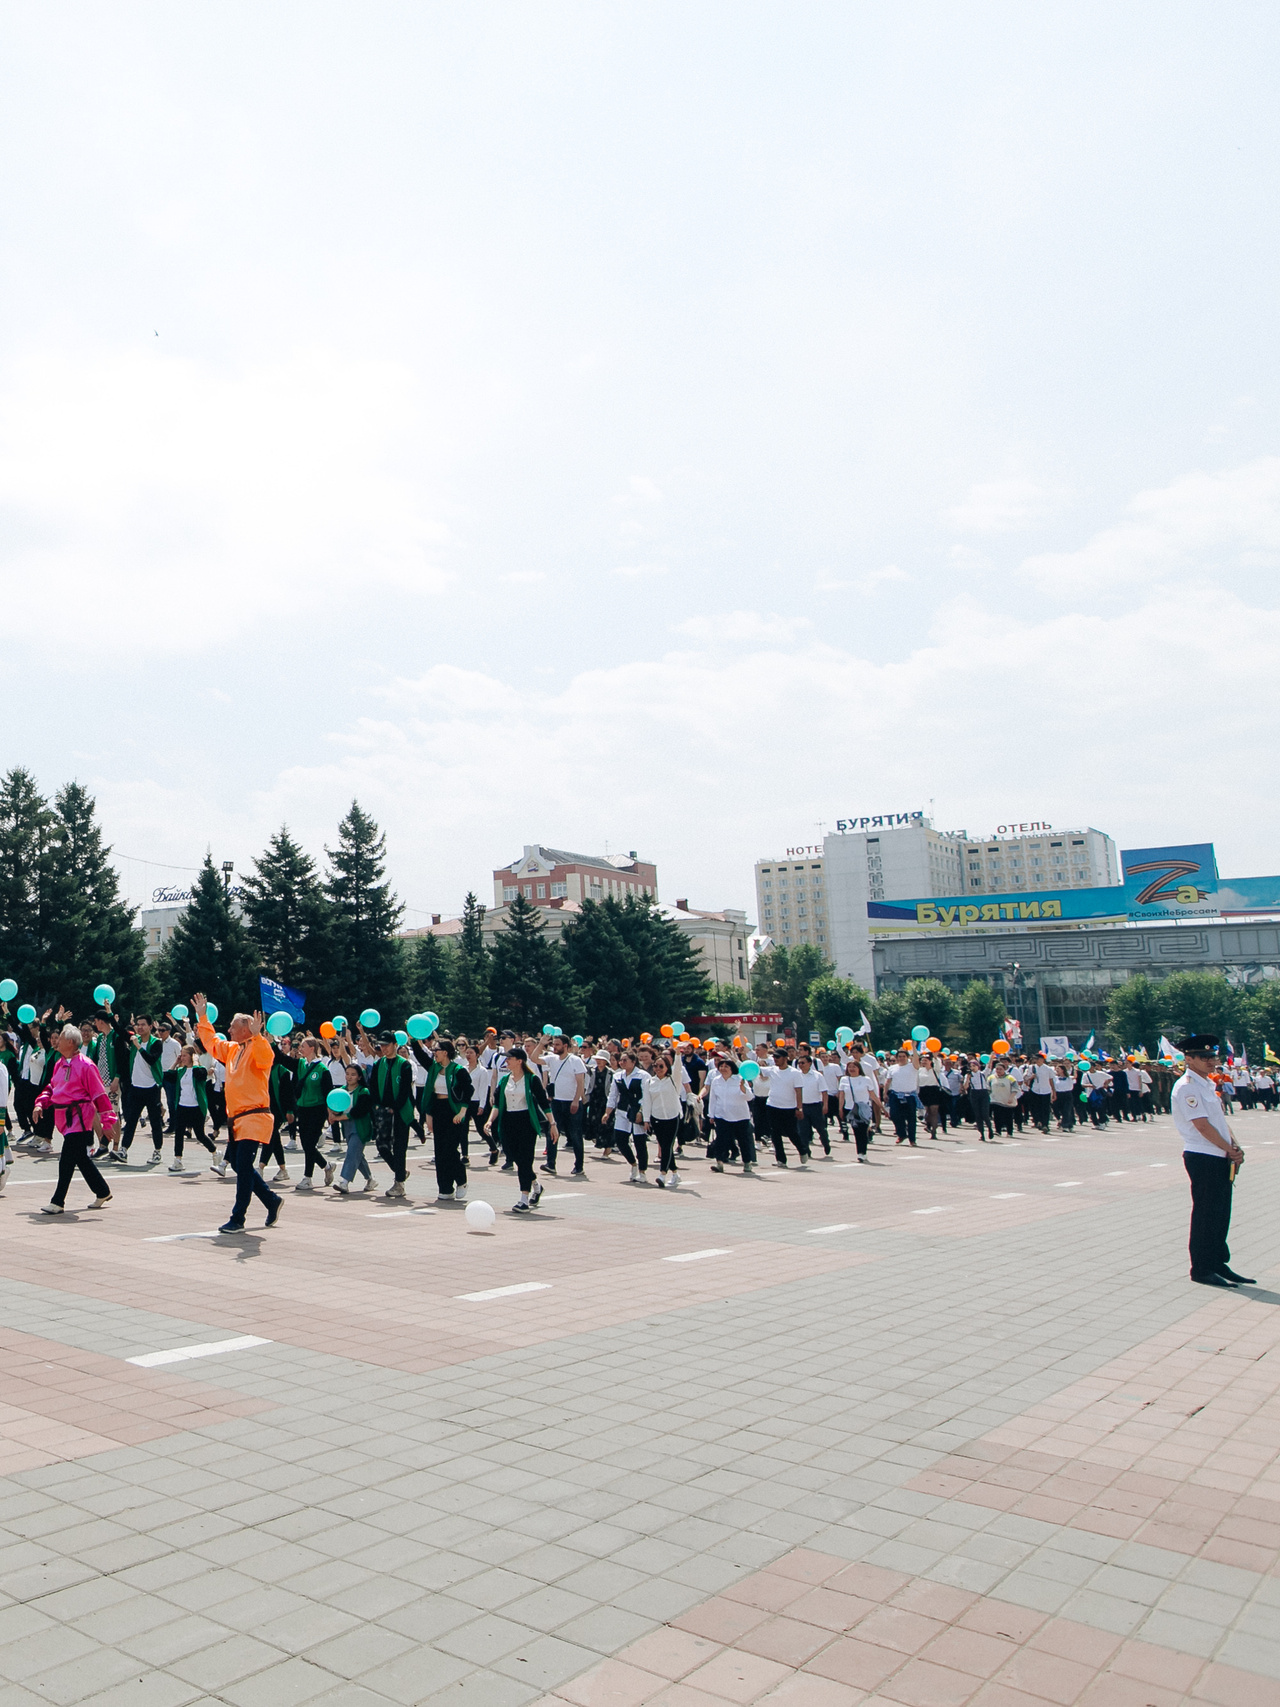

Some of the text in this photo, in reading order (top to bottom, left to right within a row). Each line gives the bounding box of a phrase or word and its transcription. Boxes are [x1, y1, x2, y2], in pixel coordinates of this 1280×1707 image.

[836, 811, 923, 831] БУРЯТИЯ
[996, 821, 1053, 834] ОТЕЛЬ
[786, 845, 824, 856] HOTE
[151, 884, 193, 903] Байка
[915, 899, 1062, 927] Бурятия
[1128, 908, 1218, 919] #СвоихНеБросаем
